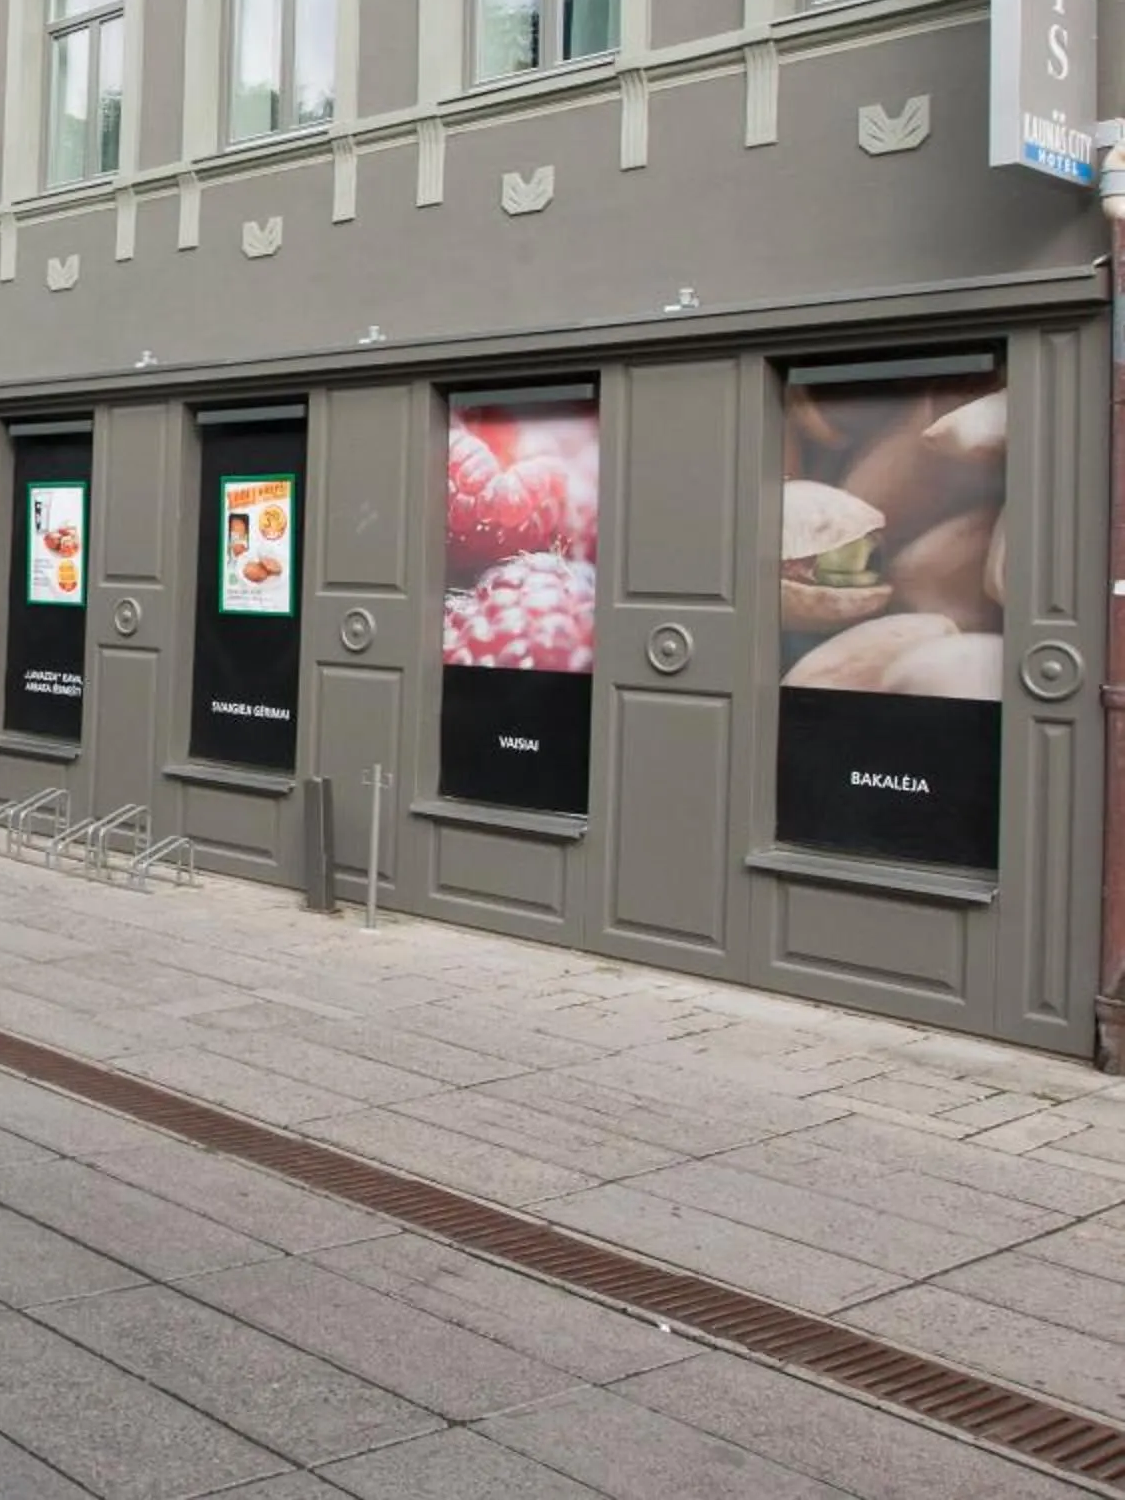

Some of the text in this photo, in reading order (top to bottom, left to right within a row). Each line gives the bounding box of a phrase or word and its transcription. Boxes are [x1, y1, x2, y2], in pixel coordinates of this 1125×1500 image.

[1068, 128, 1092, 165] CITY
[1038, 147, 1079, 176] HOTEL
[498, 735, 540, 752] VAISIAI
[851, 771, 930, 793] BAKALĖJA
